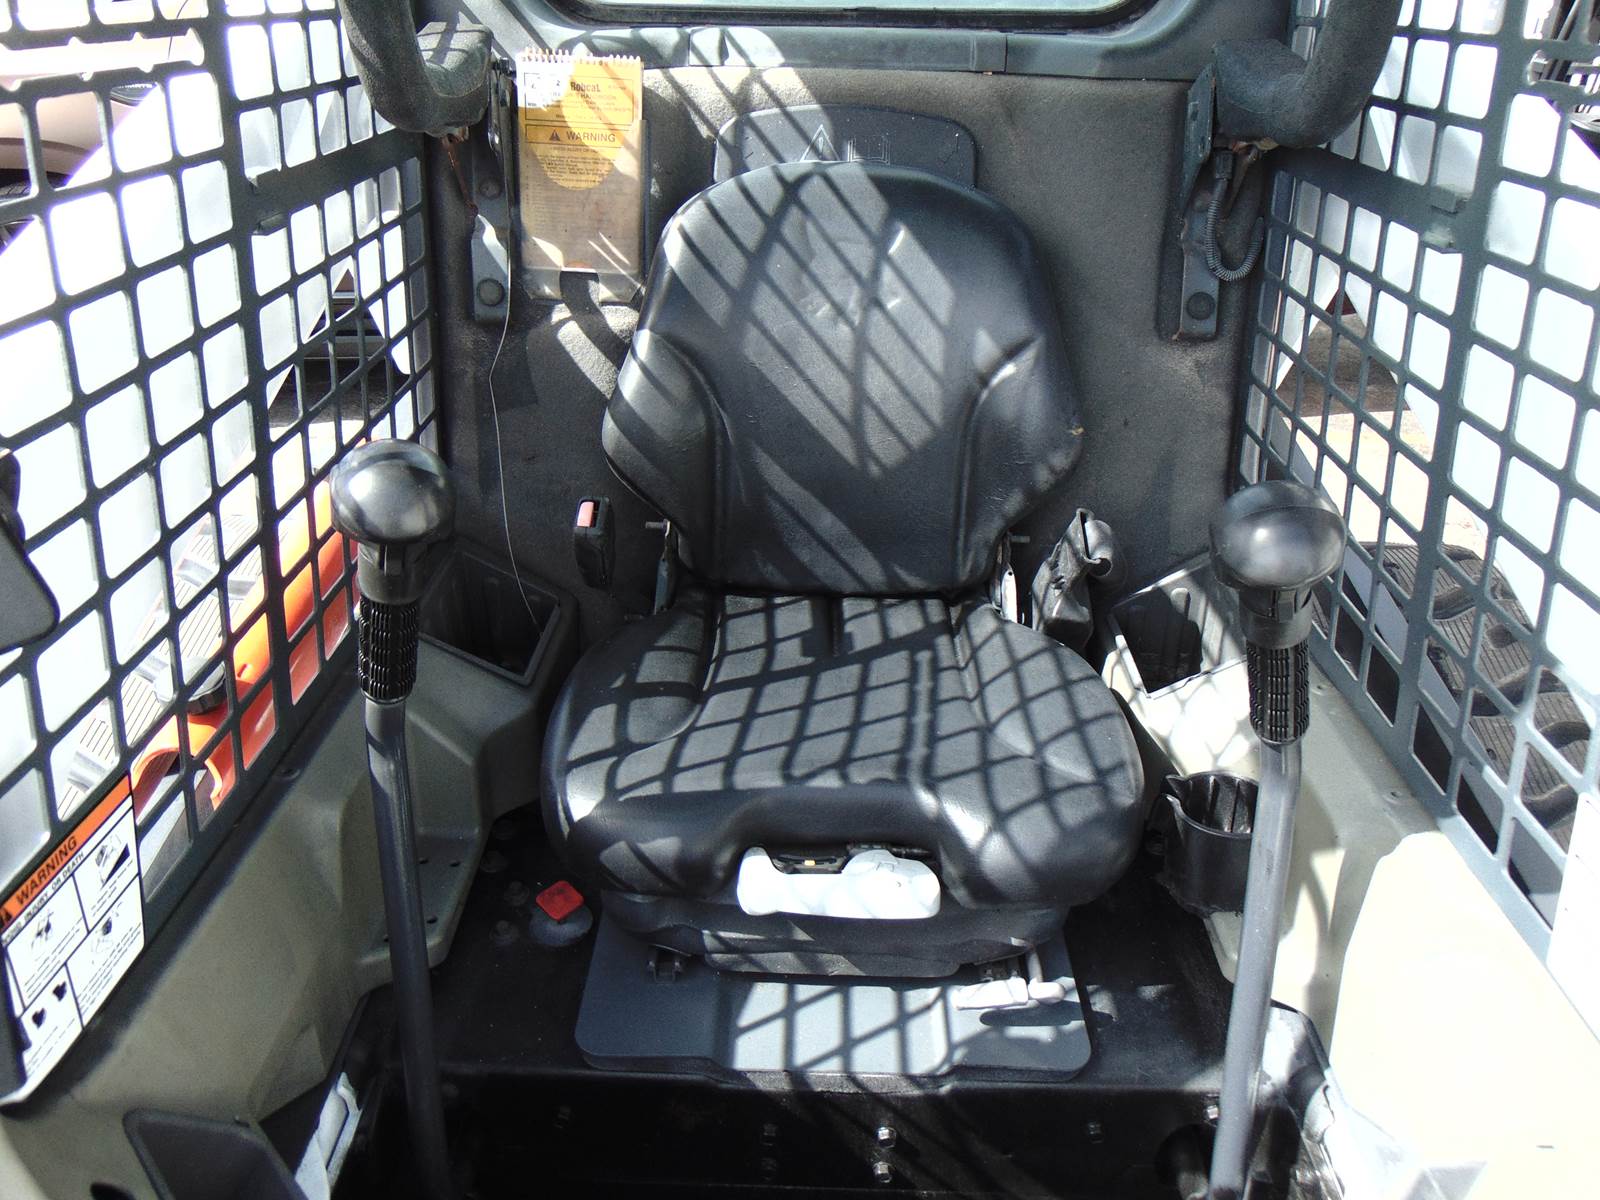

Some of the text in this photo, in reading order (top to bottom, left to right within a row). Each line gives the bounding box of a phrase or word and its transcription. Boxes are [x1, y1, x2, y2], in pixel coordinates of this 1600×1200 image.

[570, 81, 600, 92] Bobcat
[566, 131, 616, 143] WARNING
[16, 836, 77, 905] WARNING
[51, 878, 62, 891] OR
[62, 853, 84, 877] DEATH
